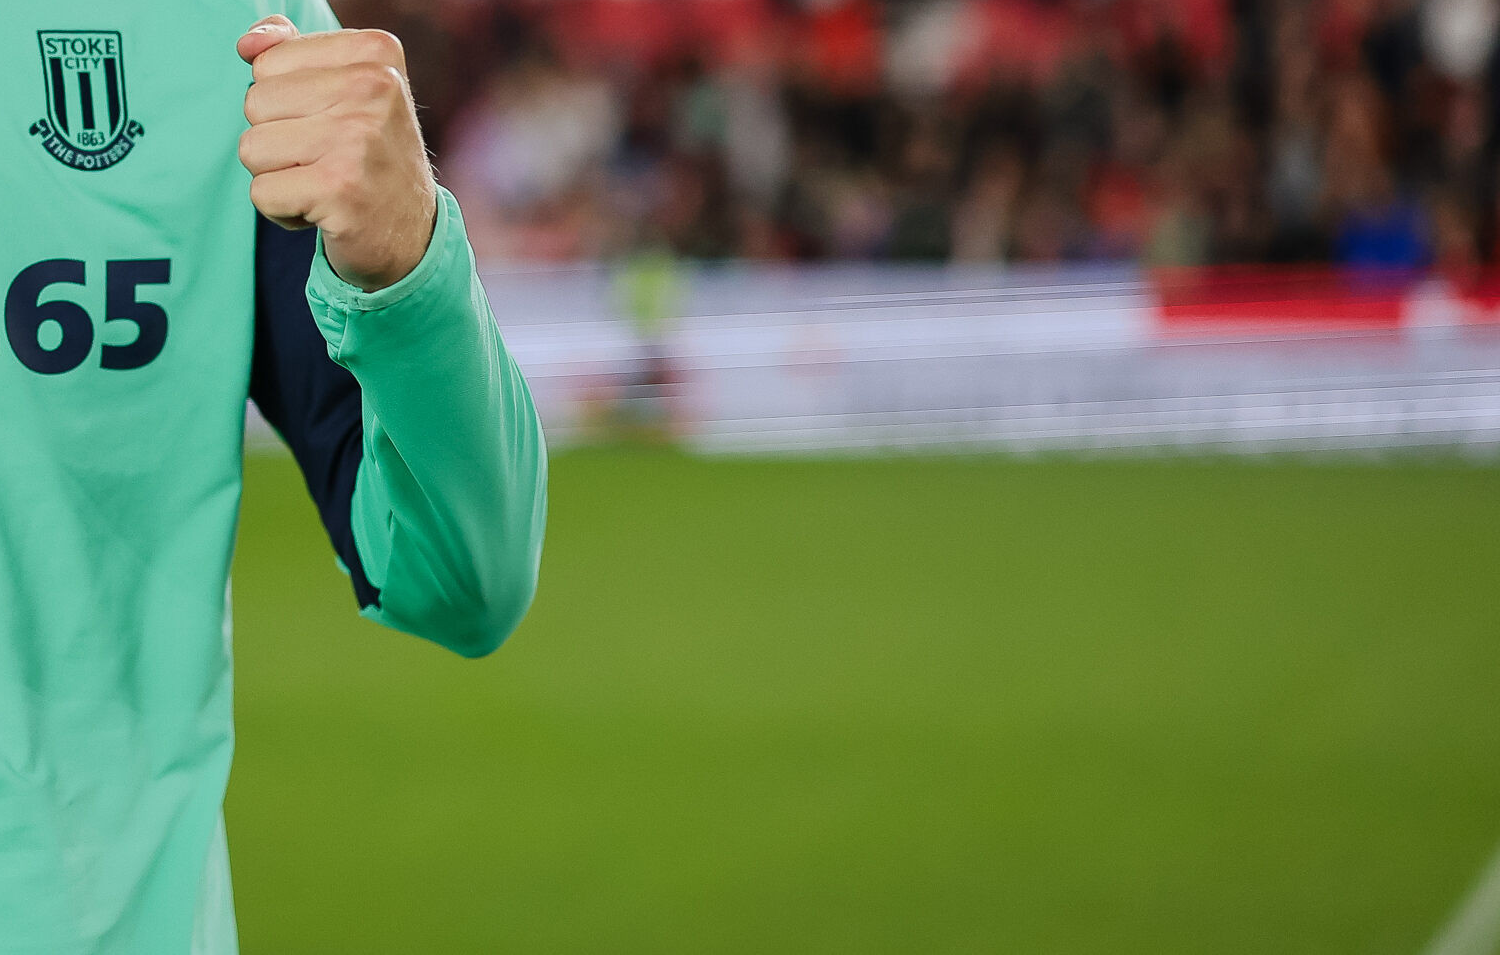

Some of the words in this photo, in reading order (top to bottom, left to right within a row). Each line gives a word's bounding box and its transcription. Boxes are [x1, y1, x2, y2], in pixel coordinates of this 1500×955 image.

[45, 38, 117, 55] STOKE
[64, 57, 100, 70] CITY
[77, 132, 105, 146] 1863
[48, 137, 73, 162] THE
[75, 138, 129, 168] POTTERS
